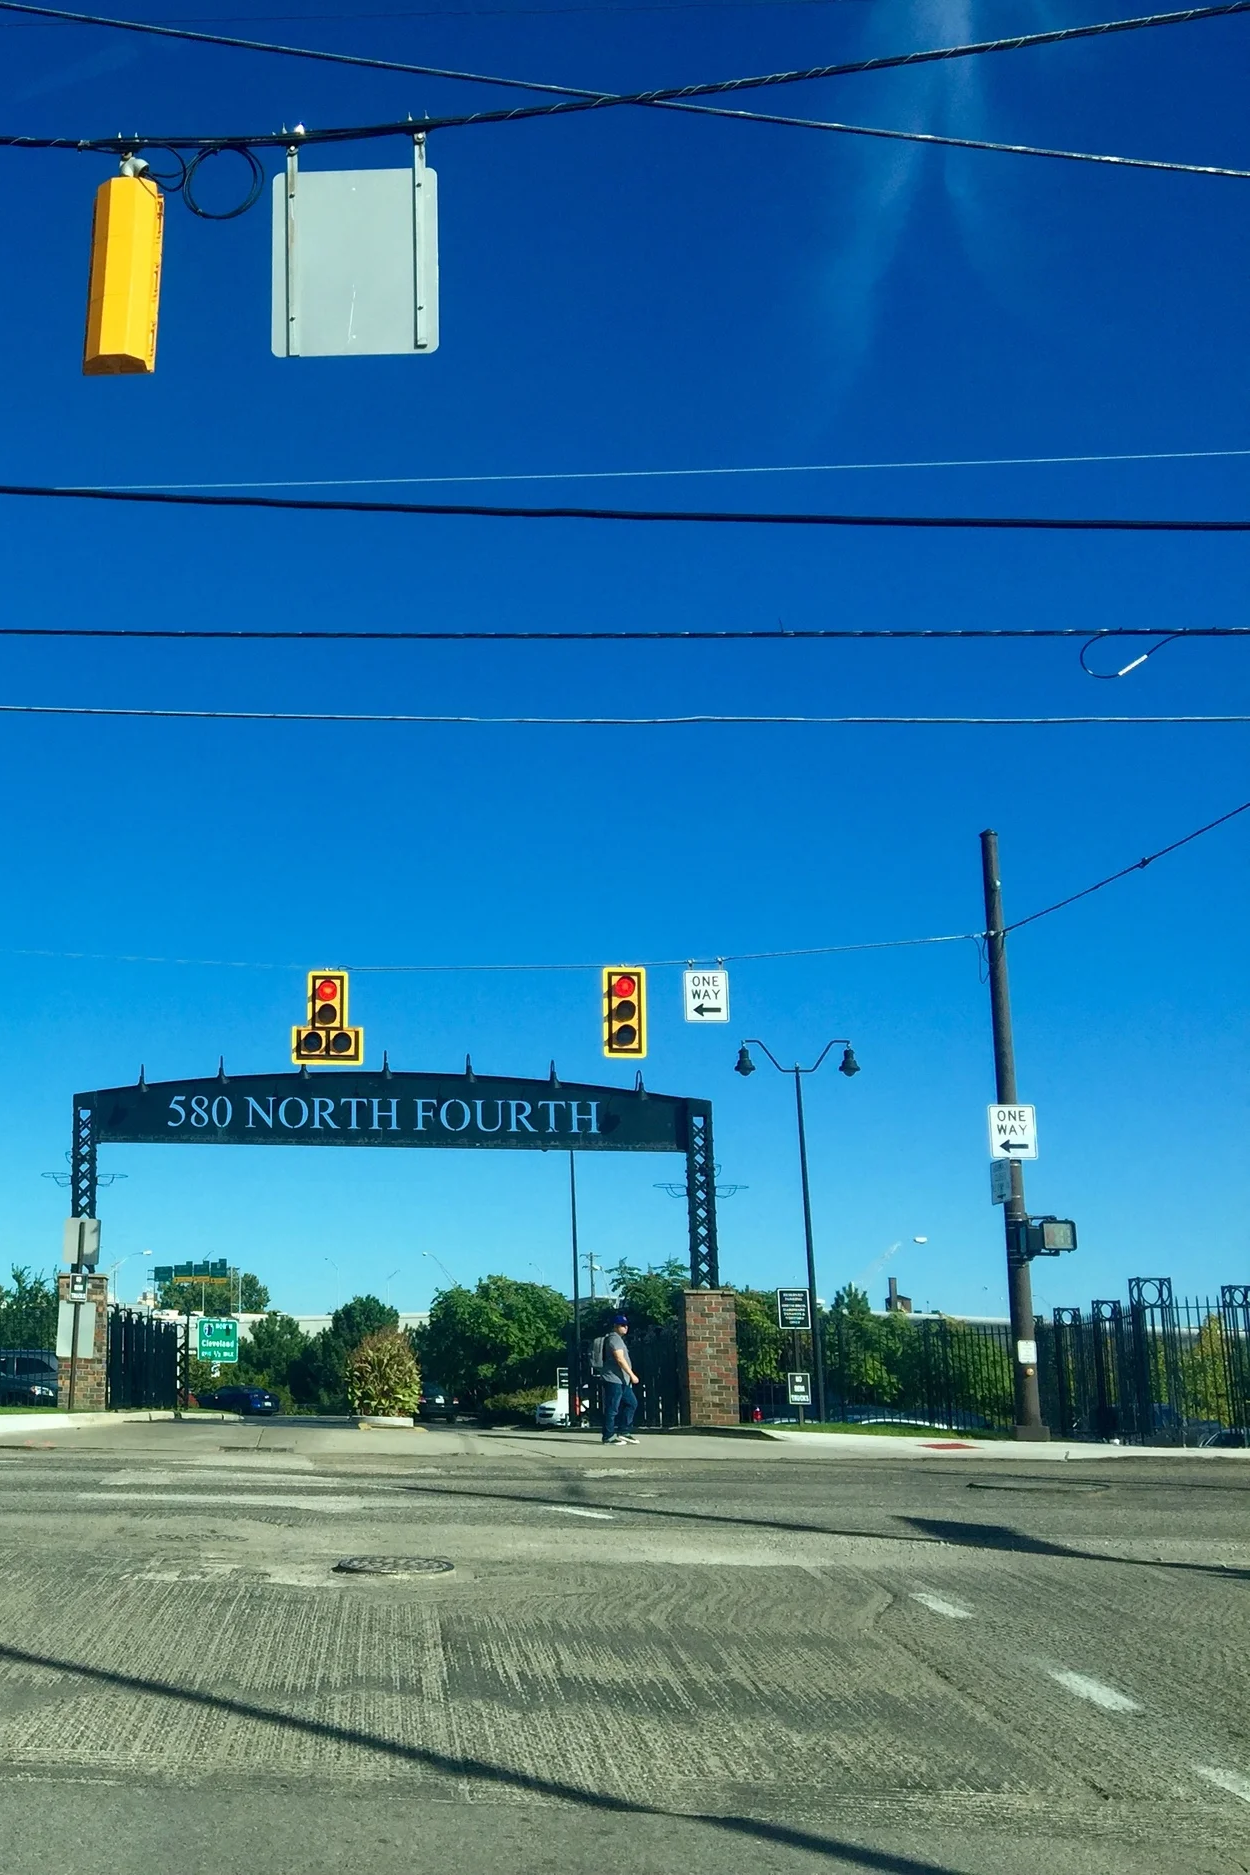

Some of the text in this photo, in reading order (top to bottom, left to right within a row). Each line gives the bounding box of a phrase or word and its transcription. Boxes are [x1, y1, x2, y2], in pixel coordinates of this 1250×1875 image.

[692, 975, 719, 987] ONE
[691, 989, 721, 1000] WAY
[167, 1095, 602, 1133] 580 NORTH FOURTH
[997, 1110, 1026, 1122] ONE
[997, 1124, 1028, 1136] WAY
